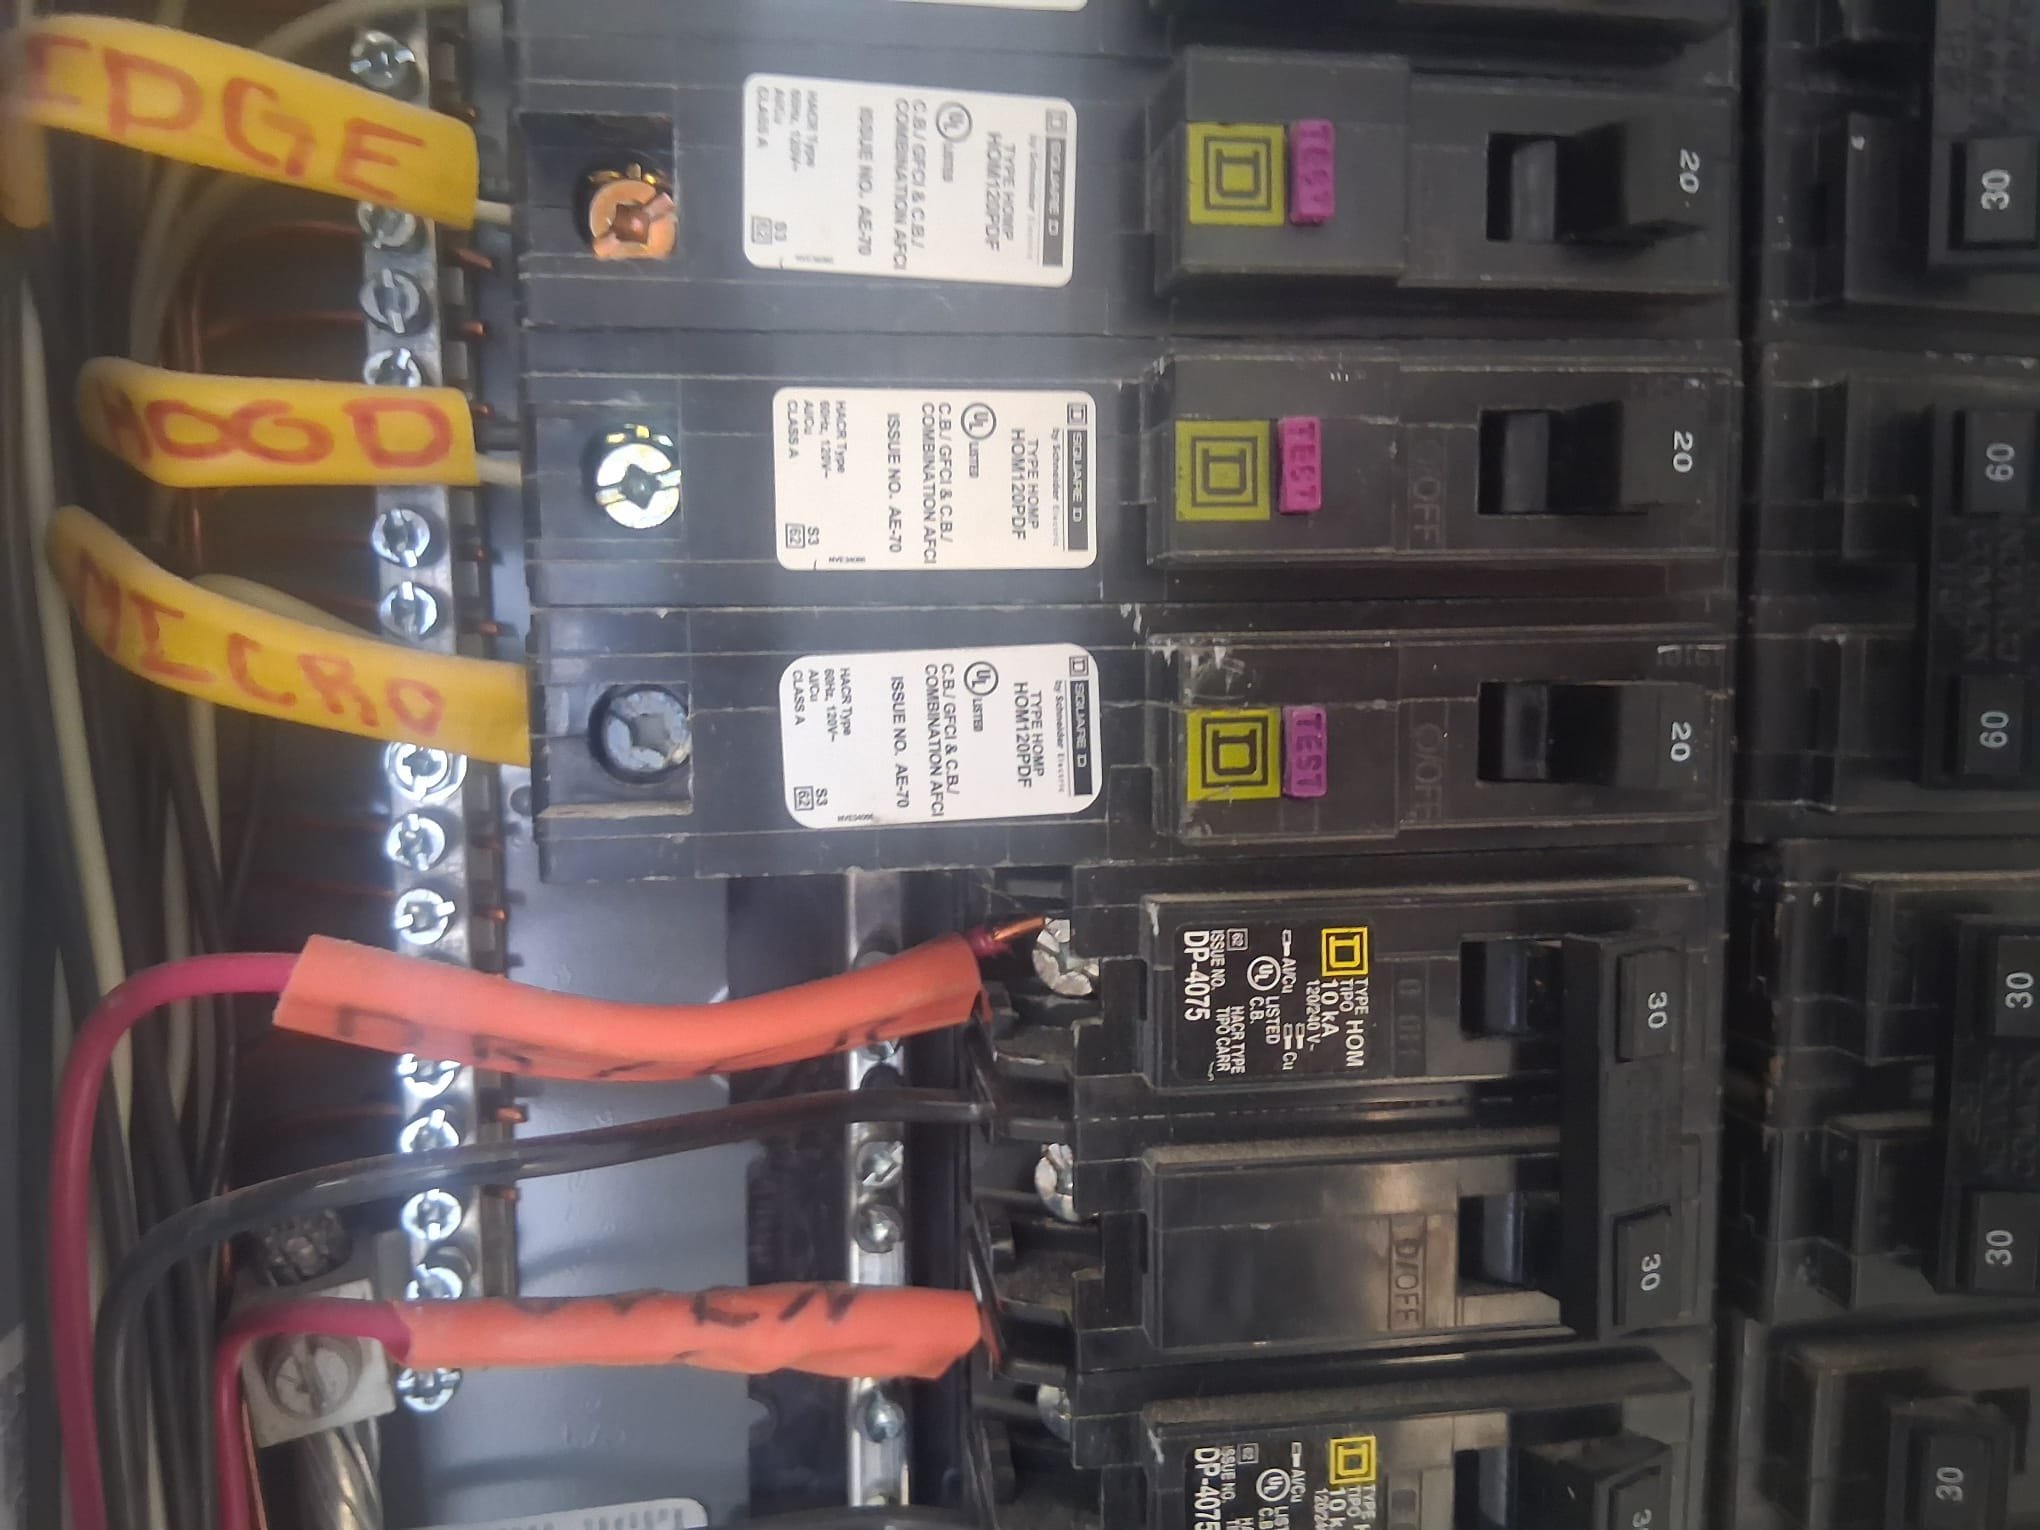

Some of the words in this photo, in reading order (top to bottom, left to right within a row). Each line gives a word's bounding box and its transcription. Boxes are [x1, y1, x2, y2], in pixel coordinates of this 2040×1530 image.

[858, 107, 873, 160] ISSUE
[894, 98, 909, 224] COMBINATION
[911, 144, 926, 188] GFCI
[1002, 144, 1016, 187] TYPE
[1680, 148, 1700, 194] 20
[858, 165, 872, 198] NO.
[985, 132, 1002, 252] HOM120PDF
[1981, 168, 2010, 210] 30
[858, 205, 872, 256] AE-70
[1002, 192, 1015, 241] HOMP
[894, 227, 908, 270] AFCI
[786, 400, 800, 446] CLASS
[836, 400, 847, 440] HACR
[887, 413, 901, 465] ISSUE
[788, 447, 800, 459] A
[834, 442, 848, 473] Type
[921, 402, 936, 523] COMBINATION
[939, 445, 952, 485] GFCI
[968, 442, 980, 479] LISTED
[1027, 439, 1040, 481] TYPE
[1071, 431, 1083, 503] SQUARE
[1289, 420, 1318, 500] TEST
[1672, 430, 1693, 473] 20
[1985, 442, 2014, 482] 60
[887, 468, 901, 499] NO.
[1010, 428, 1026, 540] HOM120PDF
[1052, 444, 1061, 501] Schneider
[939, 488, 953, 501] &
[1027, 483, 1040, 530] HOMP
[807, 526, 820, 546] S3
[888, 506, 902, 553] AE-70
[924, 525, 937, 565] AFCI
[74, 552, 446, 732] MICRO
[792, 670, 806, 712] CLASS
[840, 668, 852, 705] HACR
[891, 676, 906, 726] ISSUE
[1054, 680, 1064, 693] by
[794, 714, 806, 726] A
[840, 706, 853, 736] Type
[925, 664, 942, 777] COMBINATION
[943, 702, 958, 740] GFCI
[972, 698, 983, 732] LISTED
[1030, 690, 1042, 730] TYPE
[1056, 695, 1065, 748] Schneider
[1074, 683, 1087, 749] SQUARE
[1978, 710, 2007, 750] 60
[893, 728, 906, 756] NO.
[945, 743, 959, 756] &
[1013, 682, 1031, 788] HOM120PDF
[1031, 732, 1044, 777] HOMP
[1294, 712, 1323, 789] TEST
[1670, 722, 1692, 762] 20
[798, 790, 811, 807] 62
[816, 788, 828, 806] S3
[895, 763, 909, 808] AE-70
[929, 779, 945, 818] AFCI
[1210, 930, 1226, 967] ISSUE
[1183, 931, 1211, 1021] DP-4075
[1211, 969, 1226, 990] NO.
[1321, 979, 1337, 1005] 10
[1340, 979, 1354, 1012] TIPO
[2005, 971, 2034, 1010] 30
[1249, 996, 1264, 1024] C.B.
[1254, 964, 1273, 983] UL
[1265, 996, 1280, 1044] LISTED
[1306, 979, 1321, 1031] 120/240
[1354, 977, 1368, 1016] TYPE
[1647, 991, 1668, 1029] 30
[1216, 1006, 1230, 1034] TIPO
[1230, 1006, 1245, 1041] HACR
[1322, 1011, 1339, 1037] kA
[1216, 1037, 1230, 1072] CARR
[1230, 1043, 1245, 1074] TYPE
[1282, 1052, 1297, 1070] Cu
[1346, 1020, 1364, 1067] HOM
[1984, 1228, 2013, 1268] 30
[1640, 1253, 1661, 1292] 30
[1220, 1446, 1236, 1480] ISSUE
[1221, 1483, 1236, 1503] NO.
[1329, 1487, 1346, 1511] 10
[1347, 1486, 1361, 1517] TIPO
[1362, 1485, 1376, 1519] TYPE
[1936, 1467, 1964, 1501] 30
